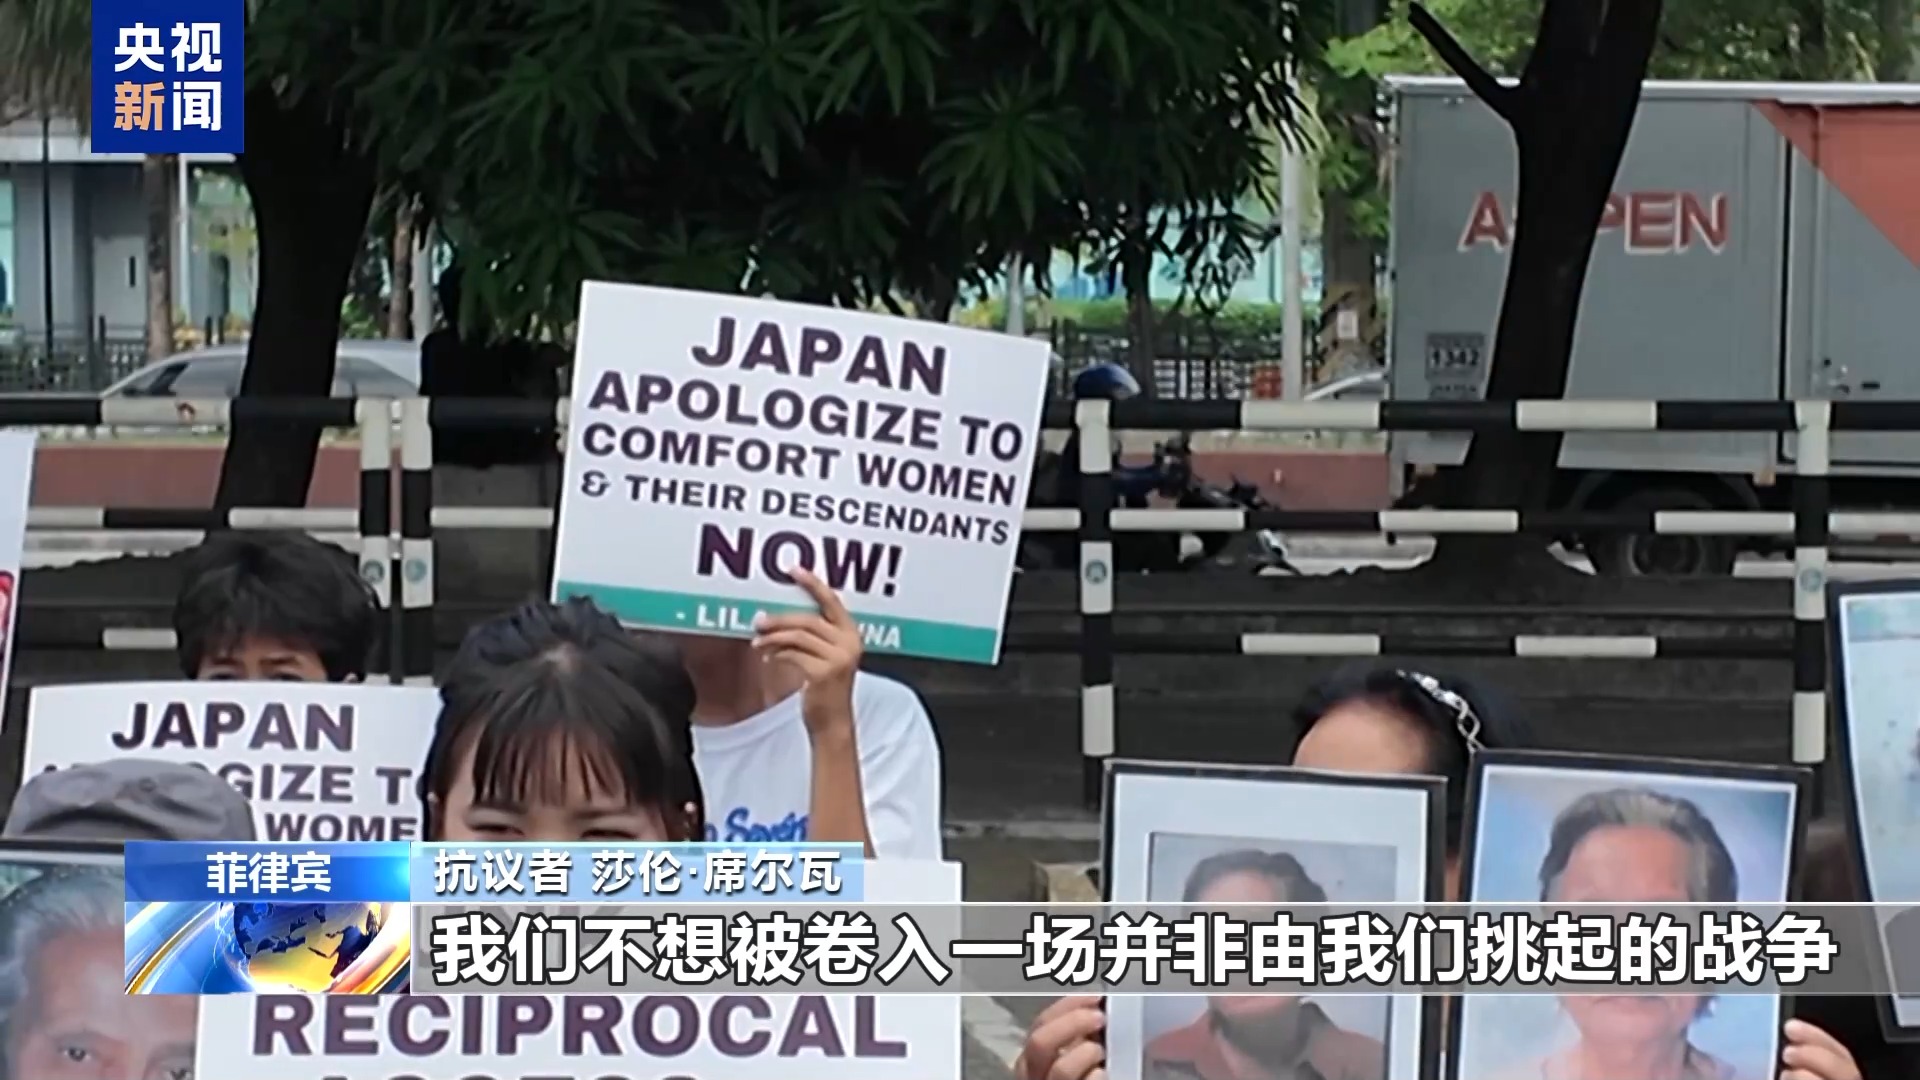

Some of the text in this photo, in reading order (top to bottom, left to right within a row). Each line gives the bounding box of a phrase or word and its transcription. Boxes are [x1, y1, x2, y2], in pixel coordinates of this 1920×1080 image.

[692, 317, 947, 397] JAPAN
[587, 371, 1024, 462] APOLOGIZE TO
[582, 423, 1017, 506] COMFORT WOMEN
[581, 471, 1010, 546] & THEIR DESCENDANTS
[697, 523, 903, 597] NOW!
[112, 702, 355, 751] JAPAN
[375, 766, 424, 805] T
[264, 812, 418, 841] WOME
[252, 994, 908, 1057] RECIPROCAL
